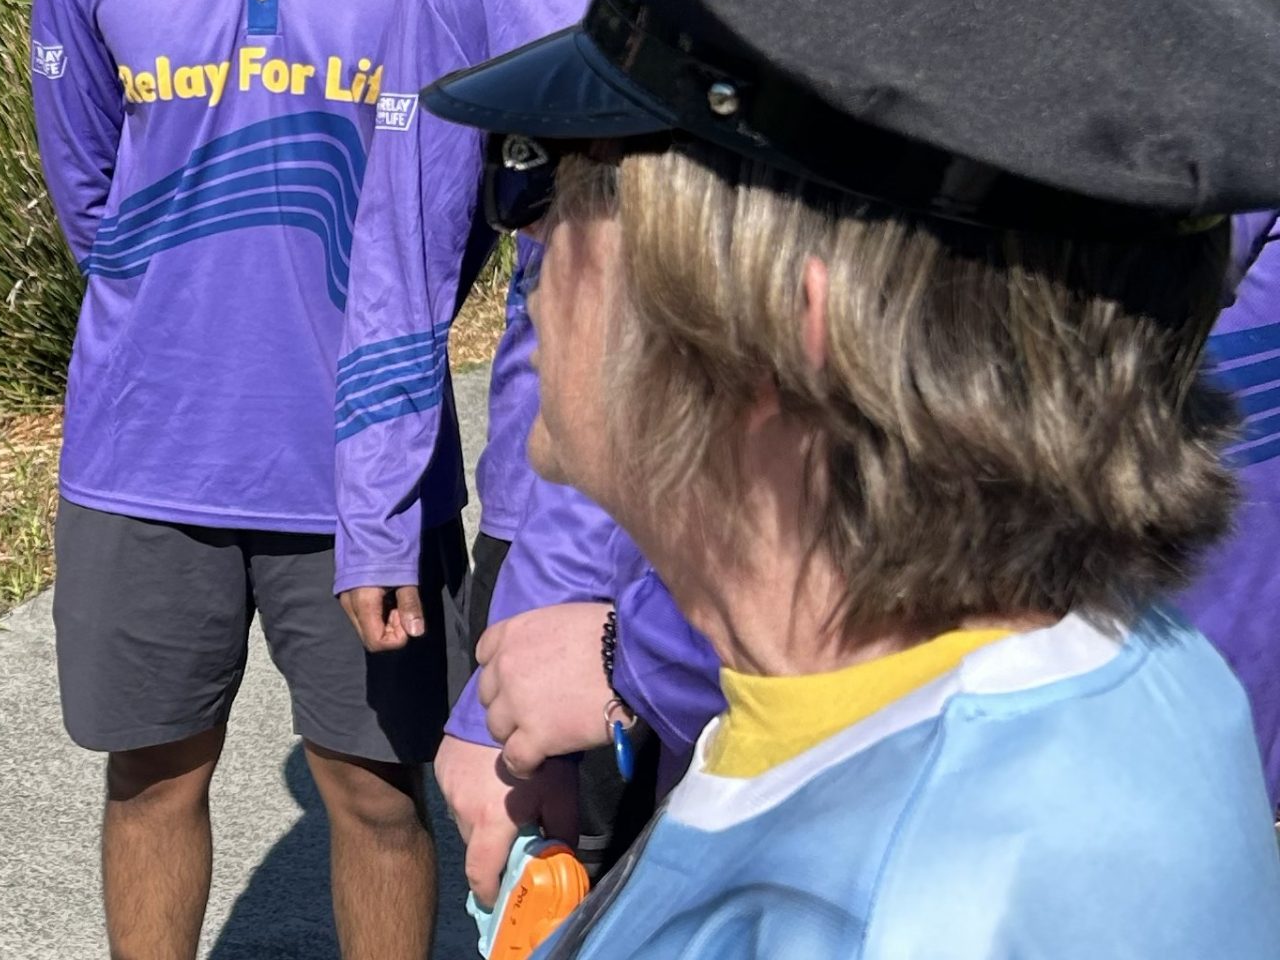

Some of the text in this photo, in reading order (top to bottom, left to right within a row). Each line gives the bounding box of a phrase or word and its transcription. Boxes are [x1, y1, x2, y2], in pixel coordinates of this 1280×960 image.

[118, 46, 383, 108] Relay For Lif
